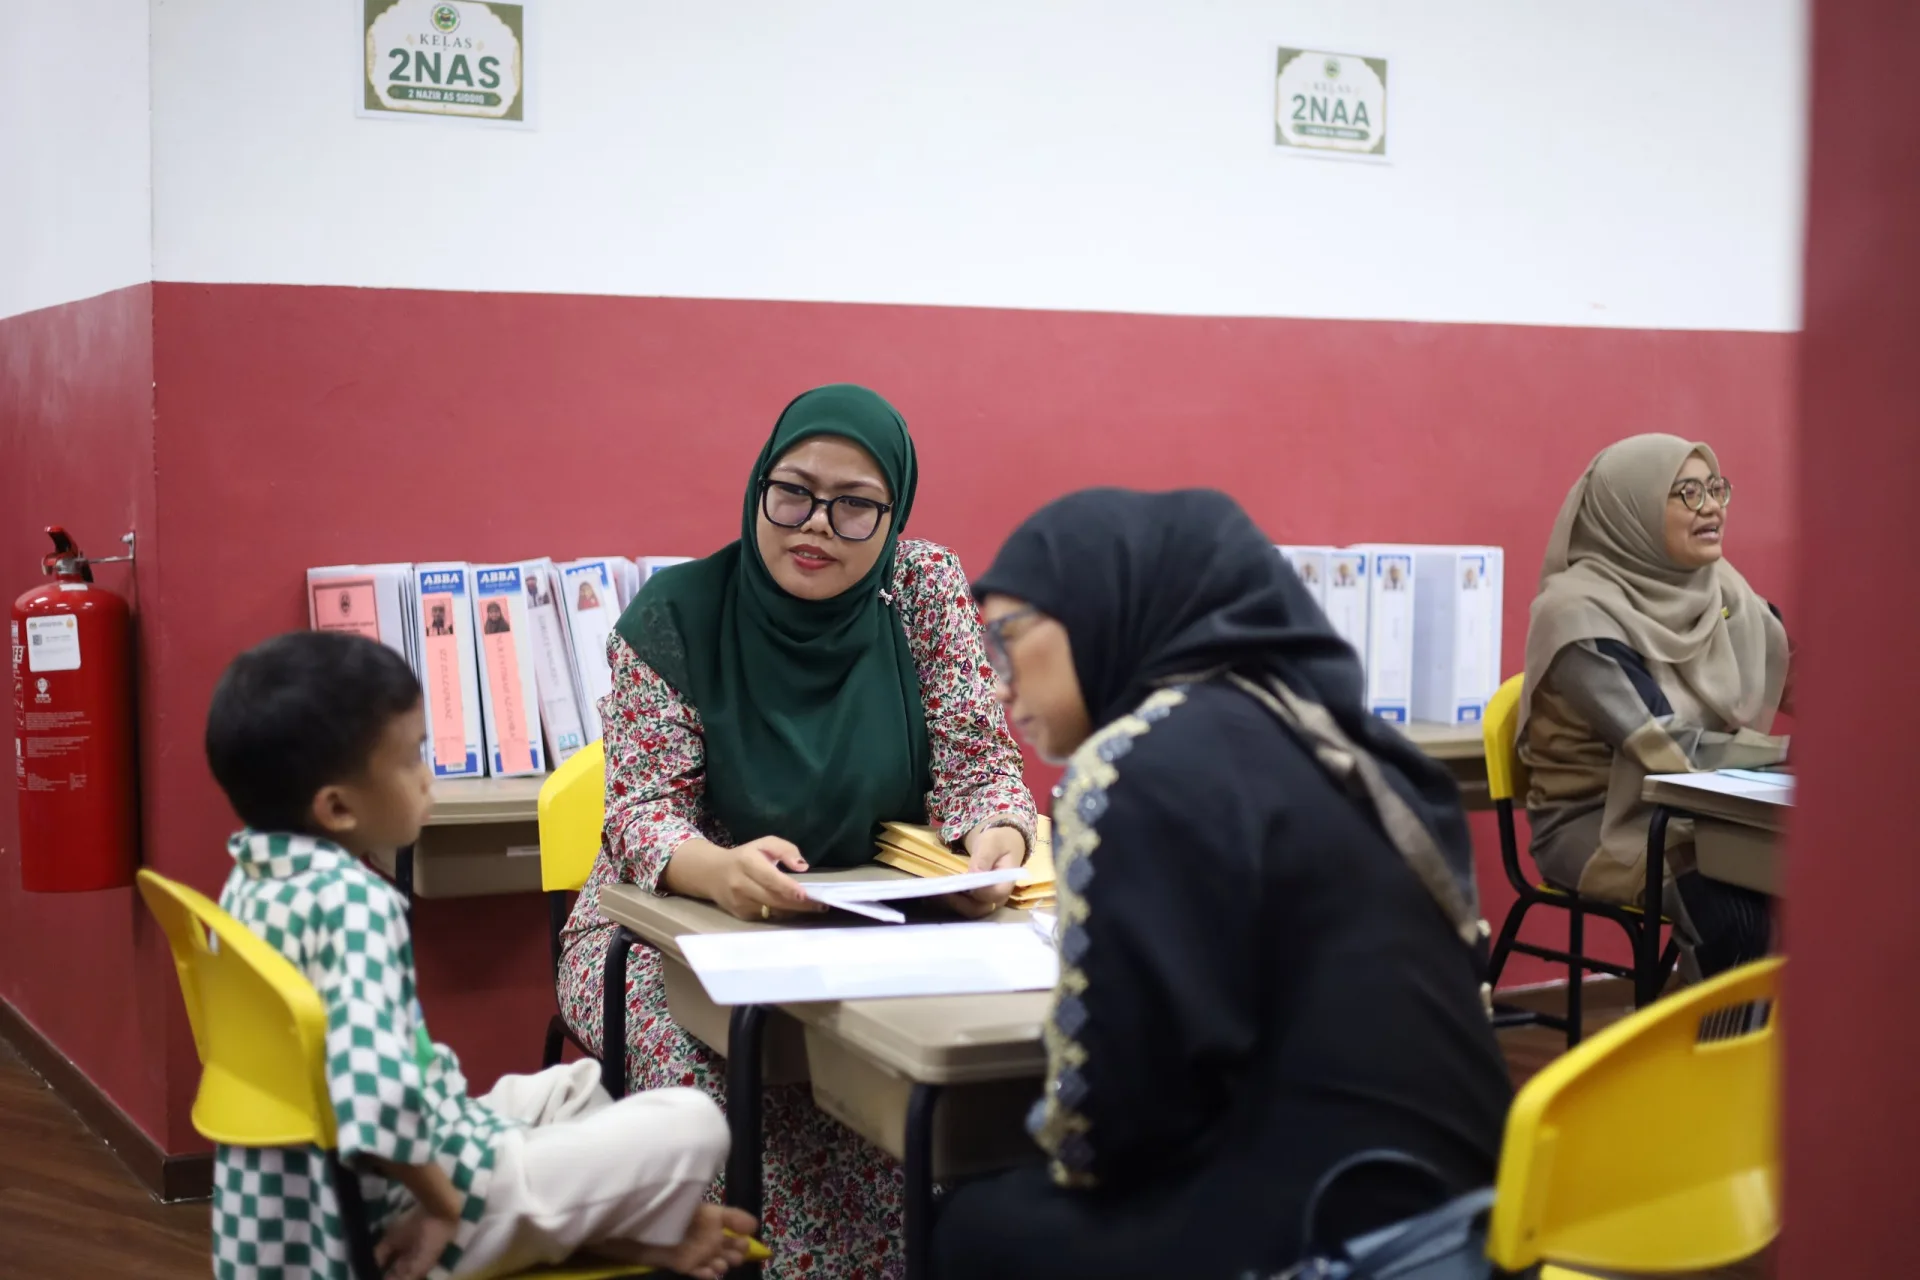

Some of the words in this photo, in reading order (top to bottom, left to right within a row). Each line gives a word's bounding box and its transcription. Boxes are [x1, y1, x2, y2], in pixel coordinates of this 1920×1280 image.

[420, 33, 472, 49] KELAS
[388, 48, 501, 89] 2NAS
[408, 89, 414, 99] 2
[443, 91, 454, 101] AS
[1291, 94, 1370, 127] 2NAA
[424, 572, 460, 586] ABBA
[480, 570, 517, 583] ABBA
